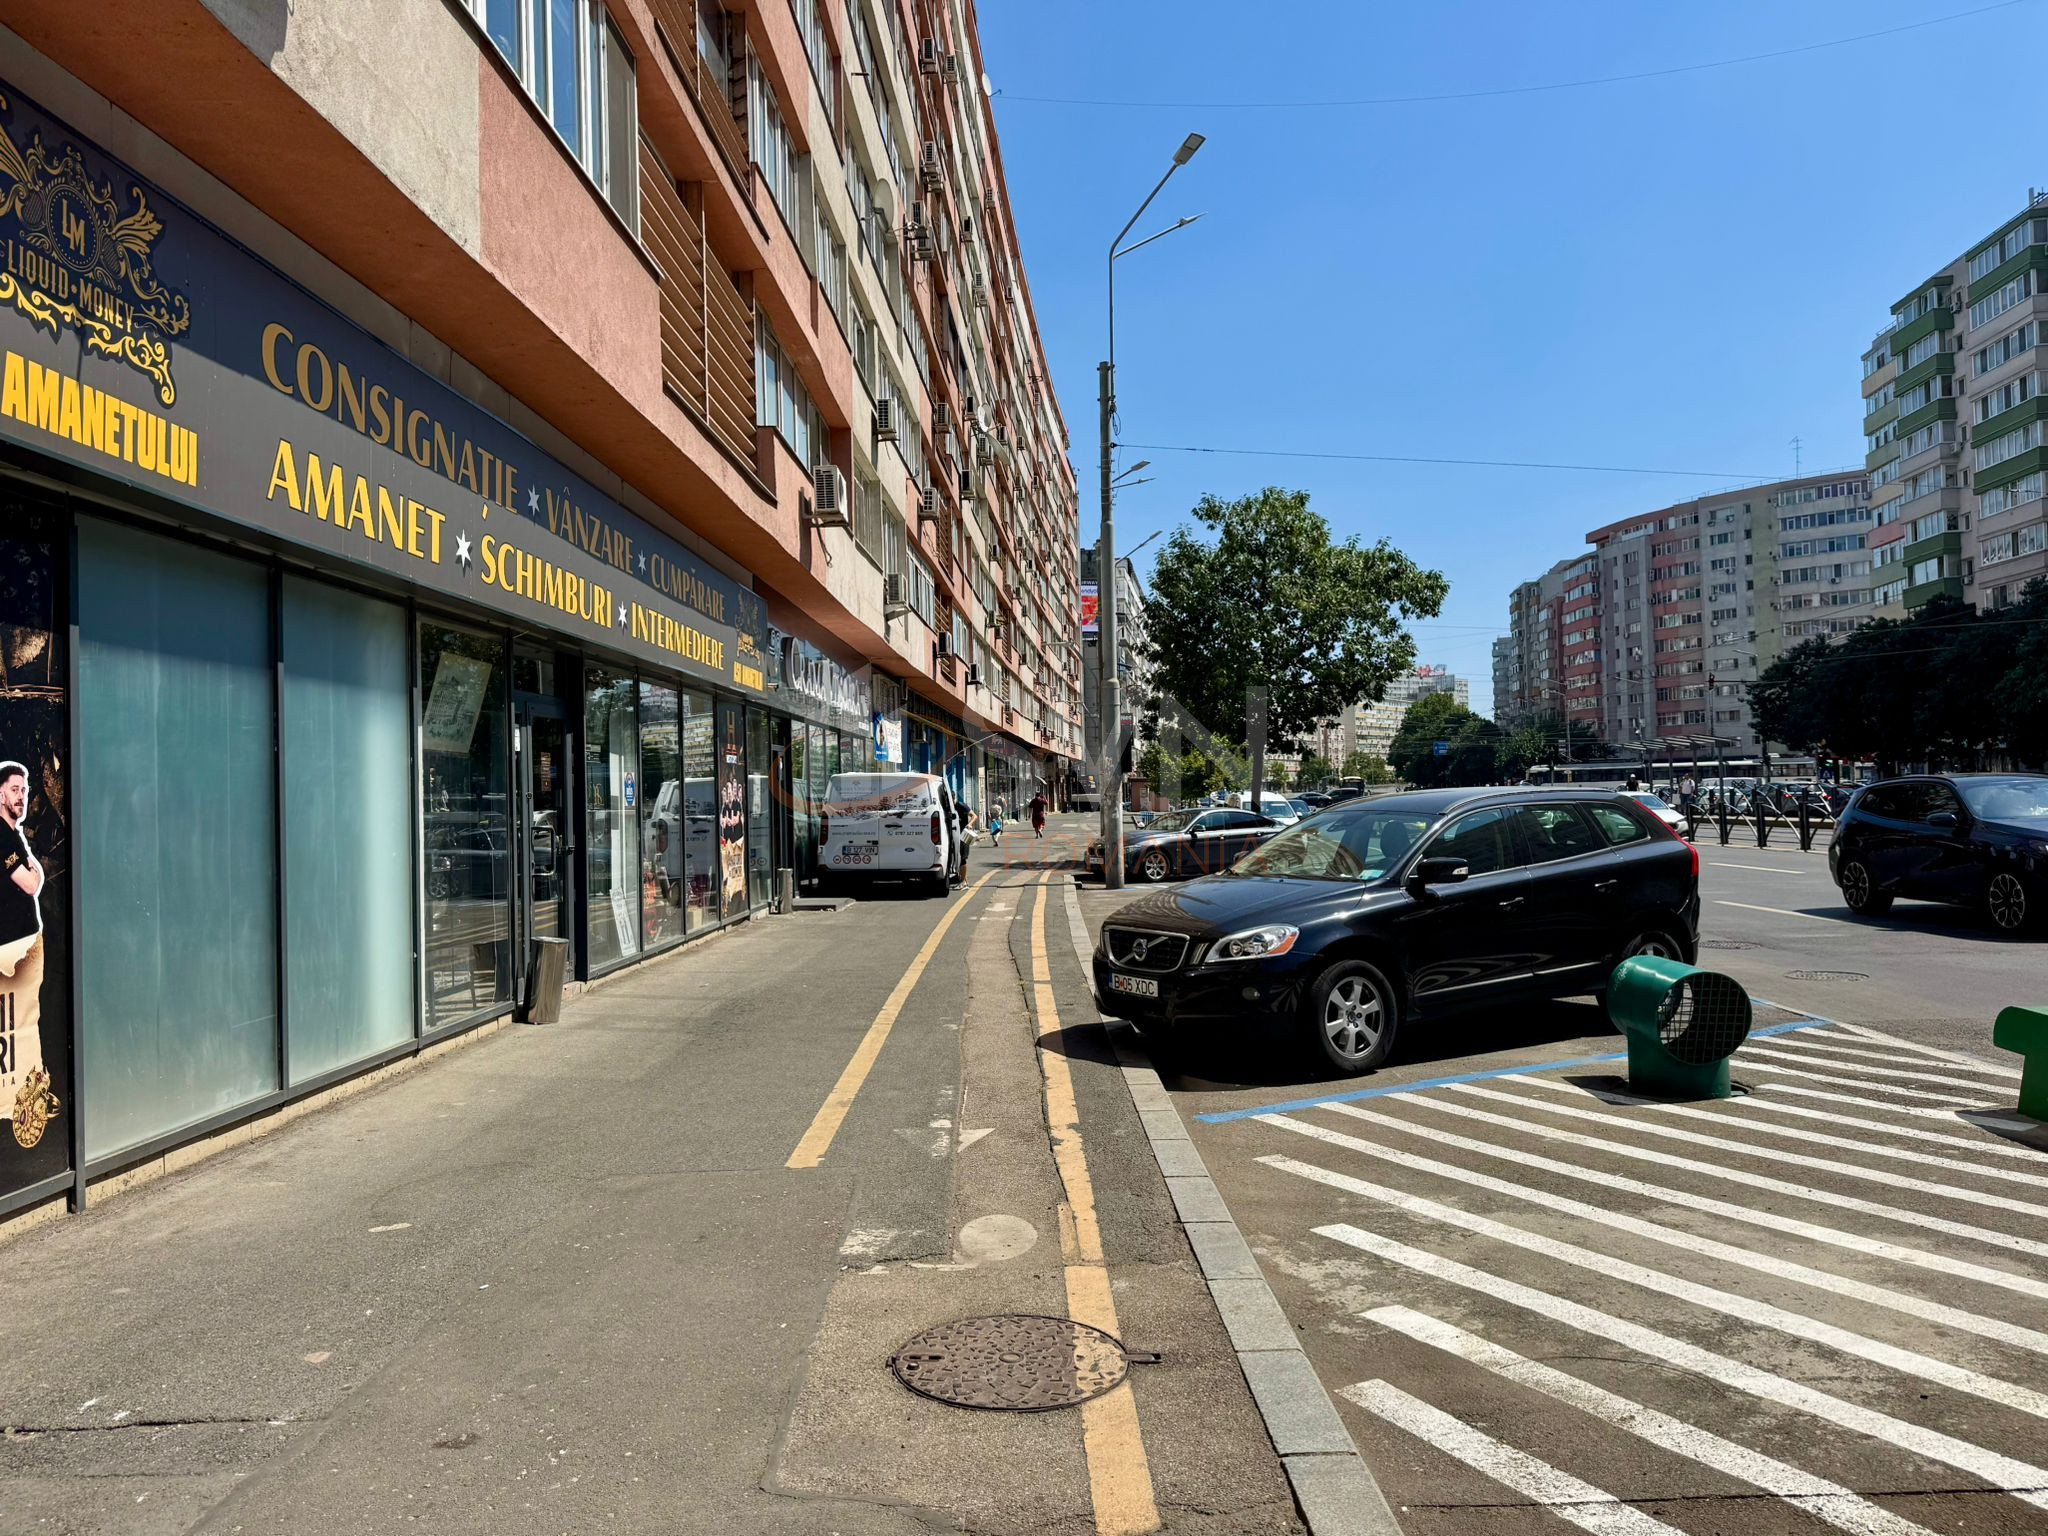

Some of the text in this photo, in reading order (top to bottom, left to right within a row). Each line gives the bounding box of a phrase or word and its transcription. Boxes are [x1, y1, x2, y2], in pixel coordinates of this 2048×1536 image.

[7, 239, 134, 333] LIQUID MONEY
[1, 351, 198, 487] AMANETULUI
[266, 438, 446, 566] AMANET
[631, 600, 725, 671] INTERMEDIERE
[544, 484, 633, 577] VÂNZARE
[650, 551, 726, 624] CUMPĂRARE
[1114, 976, 1154, 995] B 05 XDC
